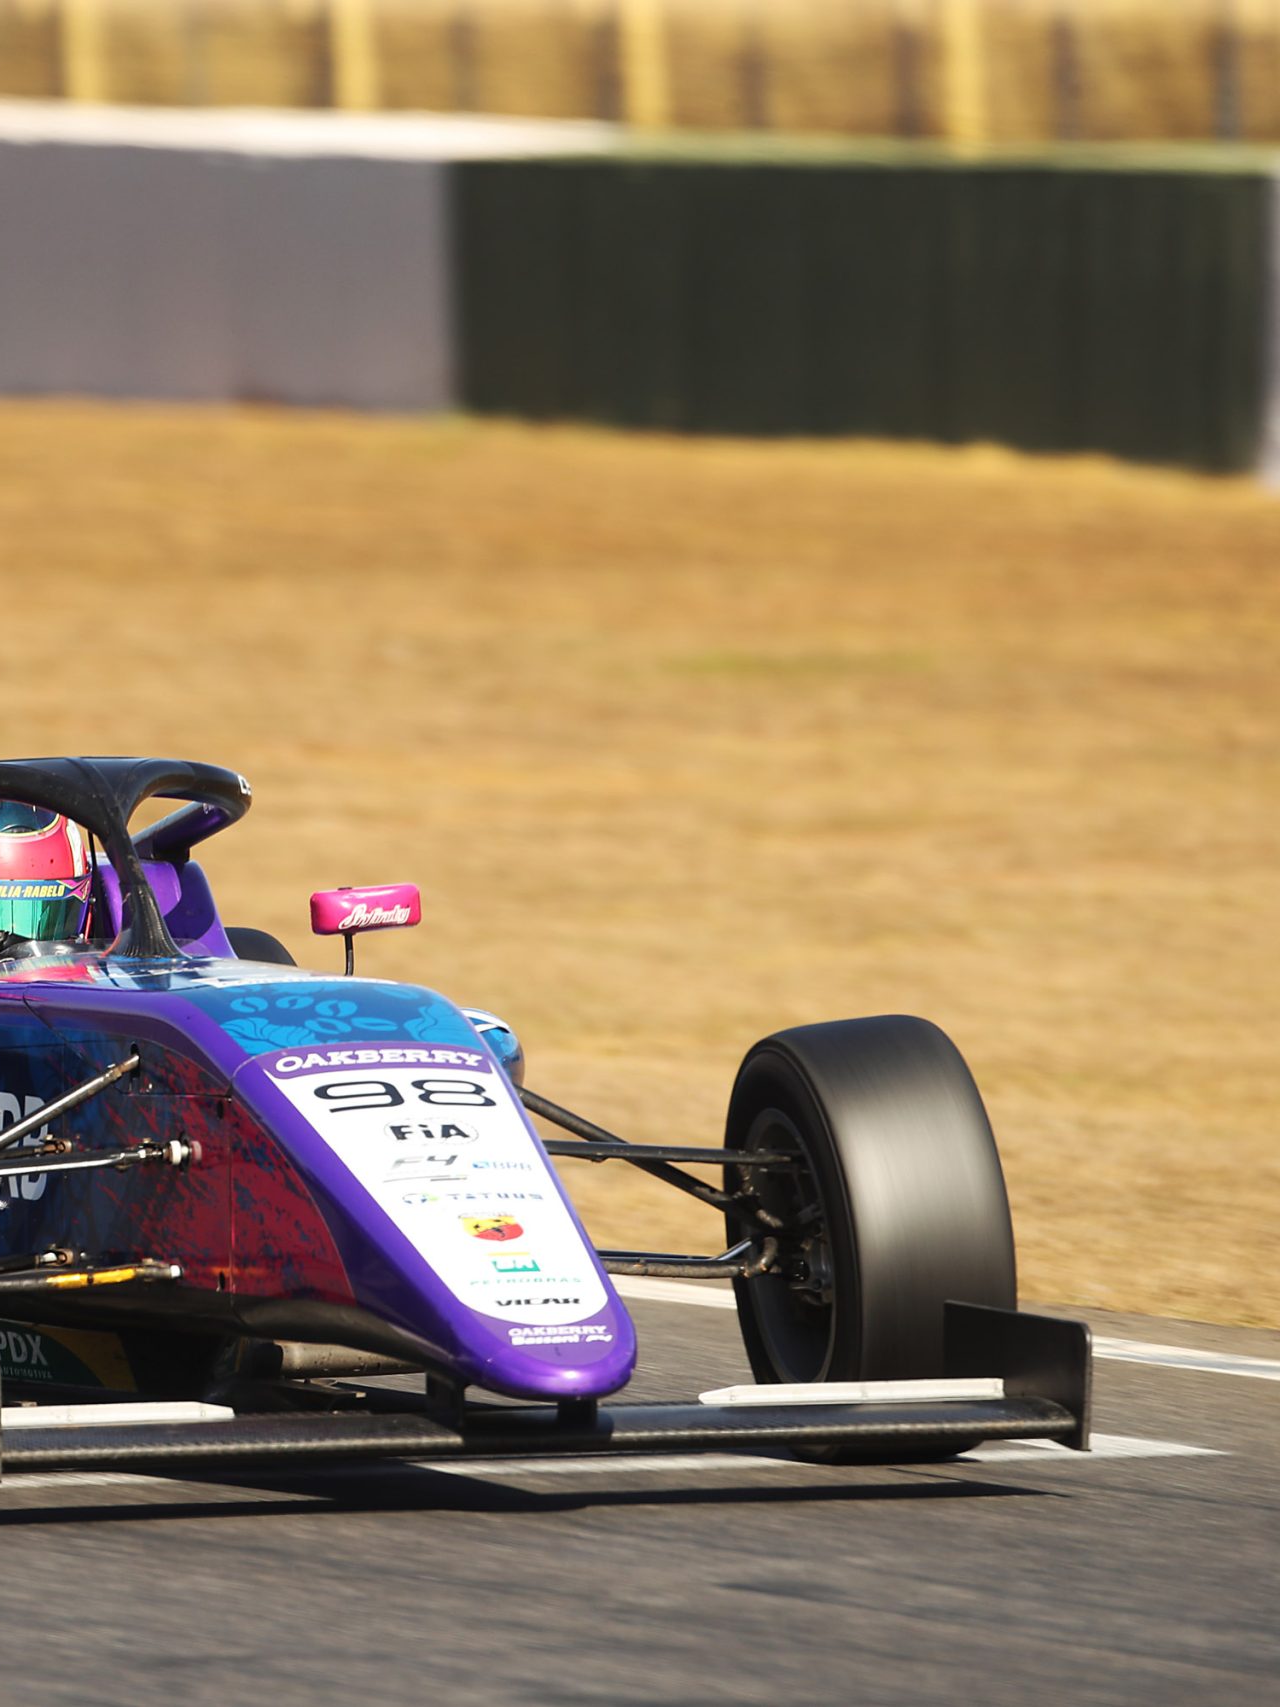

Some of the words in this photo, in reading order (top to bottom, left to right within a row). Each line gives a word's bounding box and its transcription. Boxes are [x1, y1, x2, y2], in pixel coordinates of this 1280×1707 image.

[276, 1049, 483, 1073] OAKBERRY
[314, 1079, 497, 1113] 98
[496, 1298, 580, 1307] VICAR
[508, 1325, 607, 1337] OAKBERRY
